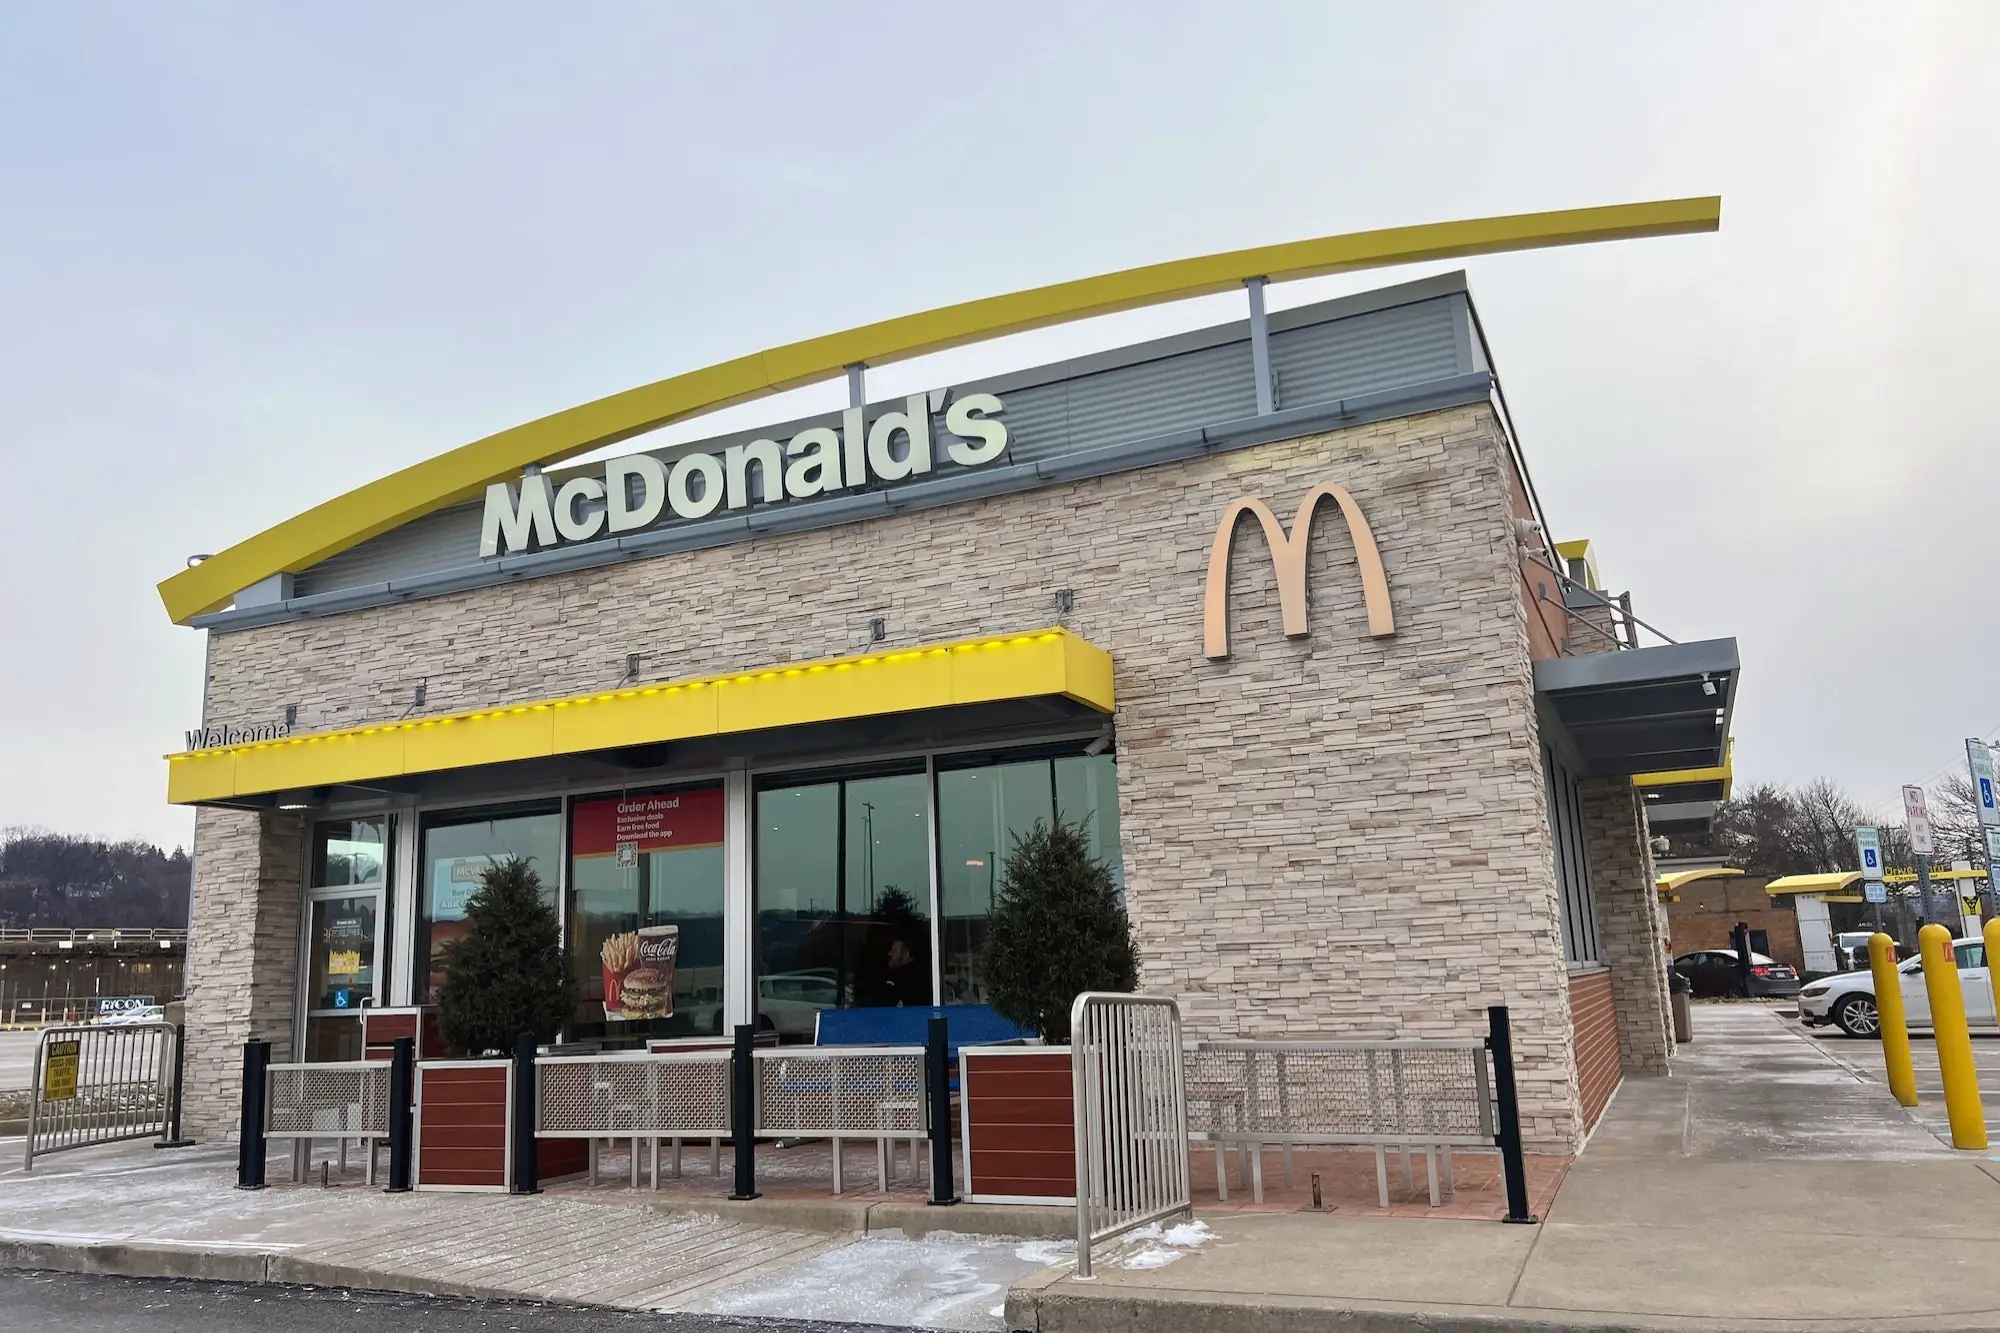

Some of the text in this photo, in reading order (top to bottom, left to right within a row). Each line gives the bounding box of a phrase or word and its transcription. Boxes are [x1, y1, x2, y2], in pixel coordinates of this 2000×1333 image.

[478, 388, 1012, 560] McDonald's
[185, 722, 291, 752] Welcome
[1909, 791, 1919, 803] NO
[617, 797, 680, 814] Order Ahead
[617, 812, 664, 823] Exclusive deals
[632, 823, 645, 831] free
[645, 821, 660, 829] food
[617, 832, 648, 841] Download
[660, 830, 672, 838] app
[1885, 866, 1914, 876] Drive
[441, 899, 459, 909] Add
[101, 999, 145, 1010] RYCON
[52, 1042, 77, 1056] CAUTION
